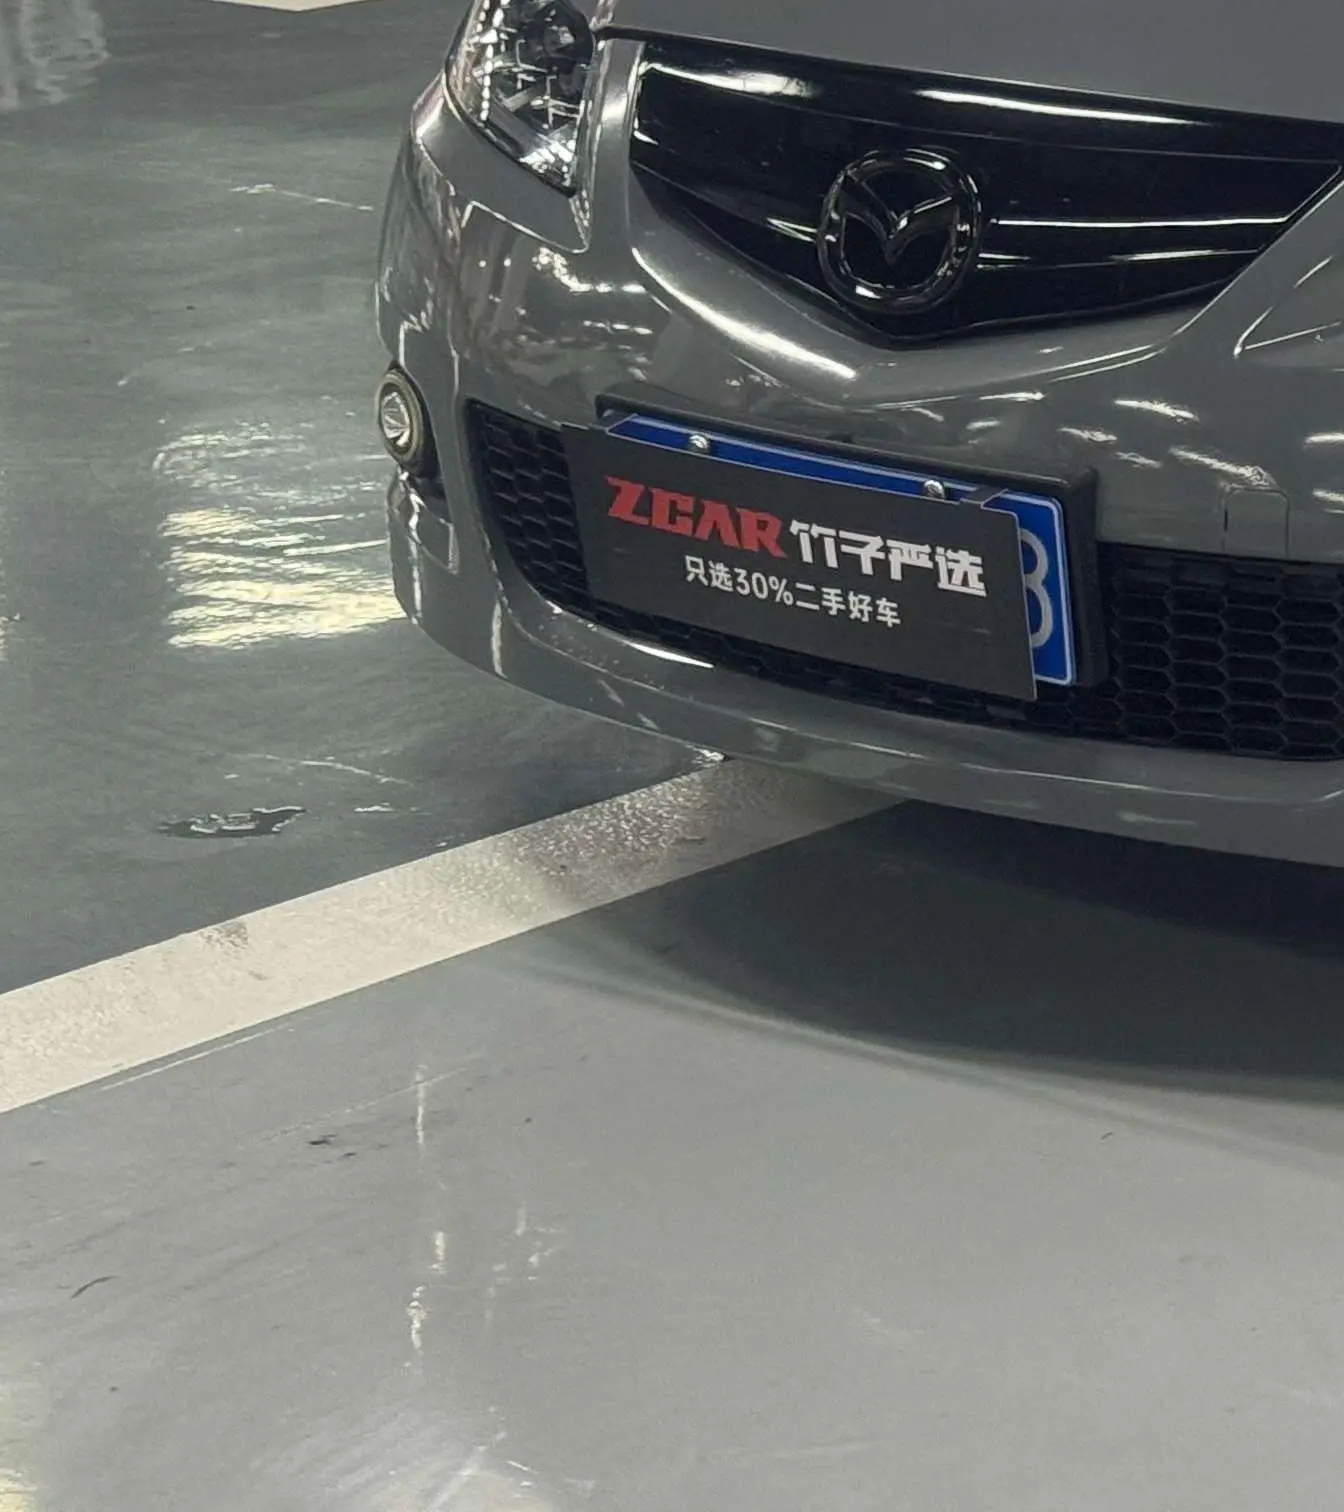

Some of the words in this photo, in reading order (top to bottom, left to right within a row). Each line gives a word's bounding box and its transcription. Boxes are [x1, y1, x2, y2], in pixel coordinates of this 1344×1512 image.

[605, 476, 788, 559] ZCAR
[789, 519, 987, 598] 竹子严选
[684, 554, 901, 629] 只选30%二手好车
